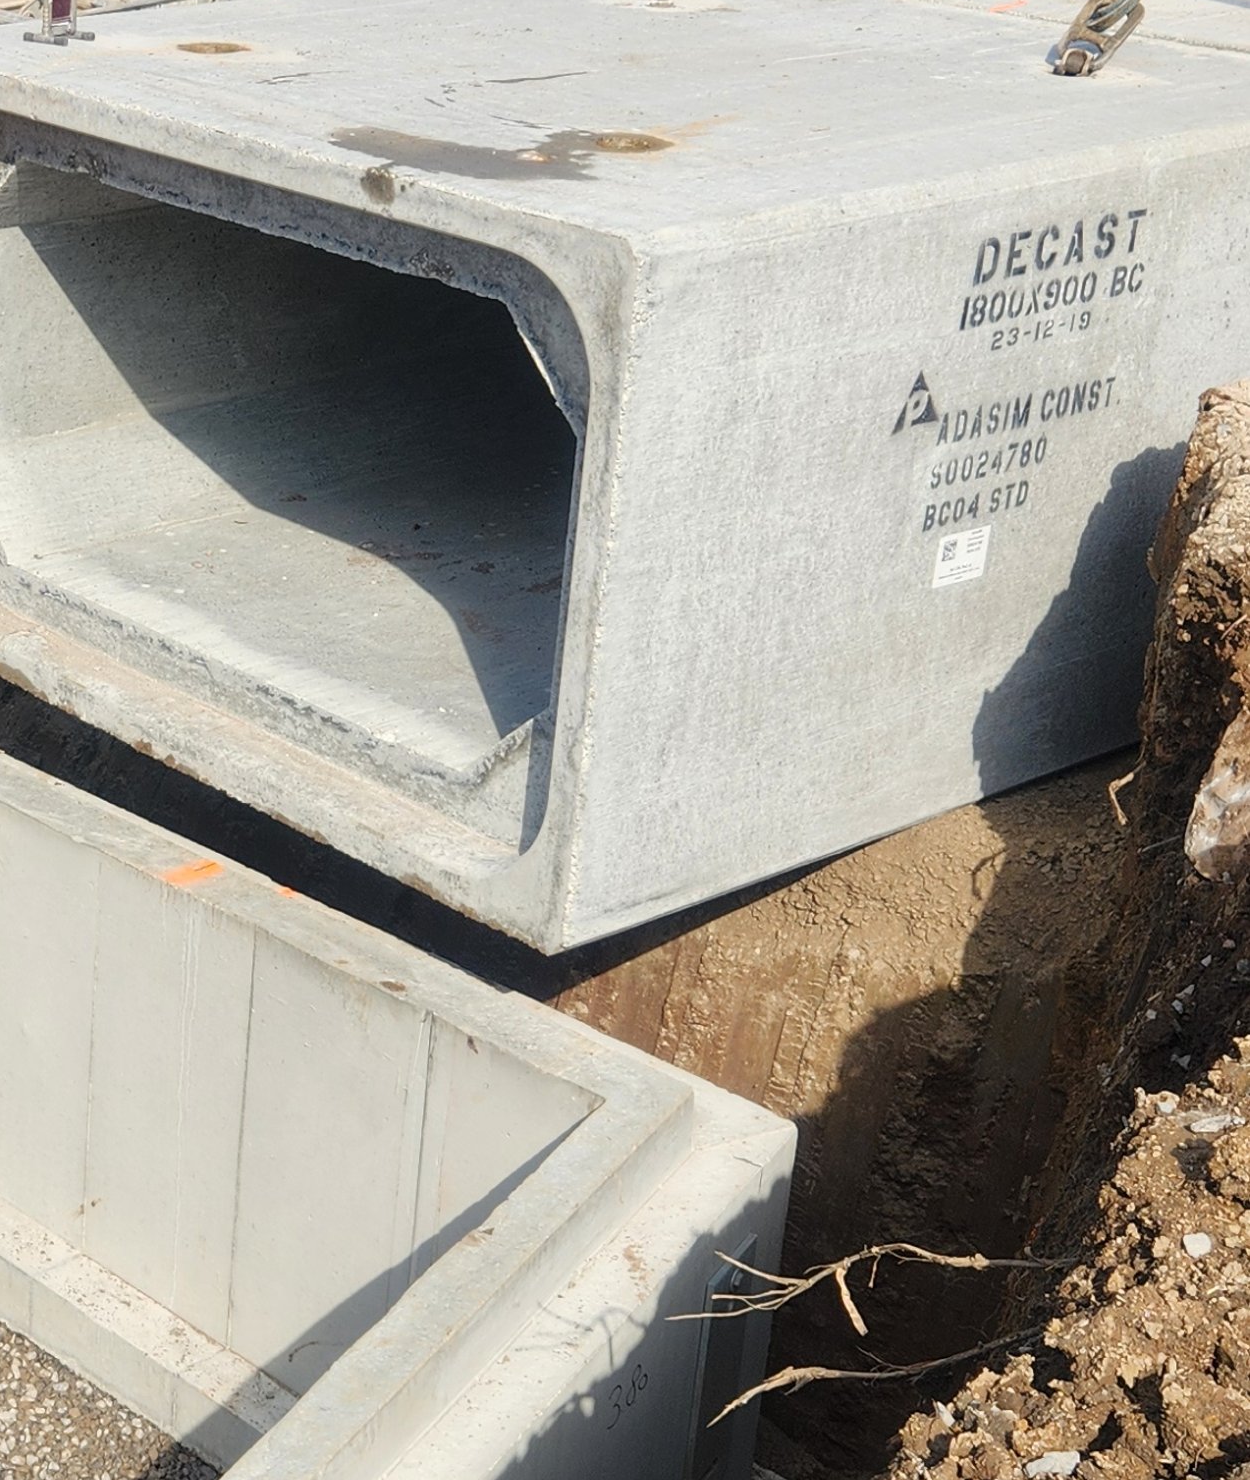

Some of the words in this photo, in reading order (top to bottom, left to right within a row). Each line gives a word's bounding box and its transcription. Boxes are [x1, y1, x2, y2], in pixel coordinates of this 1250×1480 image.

[973, 209, 1147, 287] DECAST
[959, 271, 1098, 331] 1800X900
[1109, 262, 1145, 297] BC
[991, 311, 1091, 351] 23-12-19
[936, 393, 1033, 446] ADASIM
[1040, 377, 1121, 422] CONST.
[989, 480, 1030, 513] STD
[606, 1363, 649, 1431] 380
